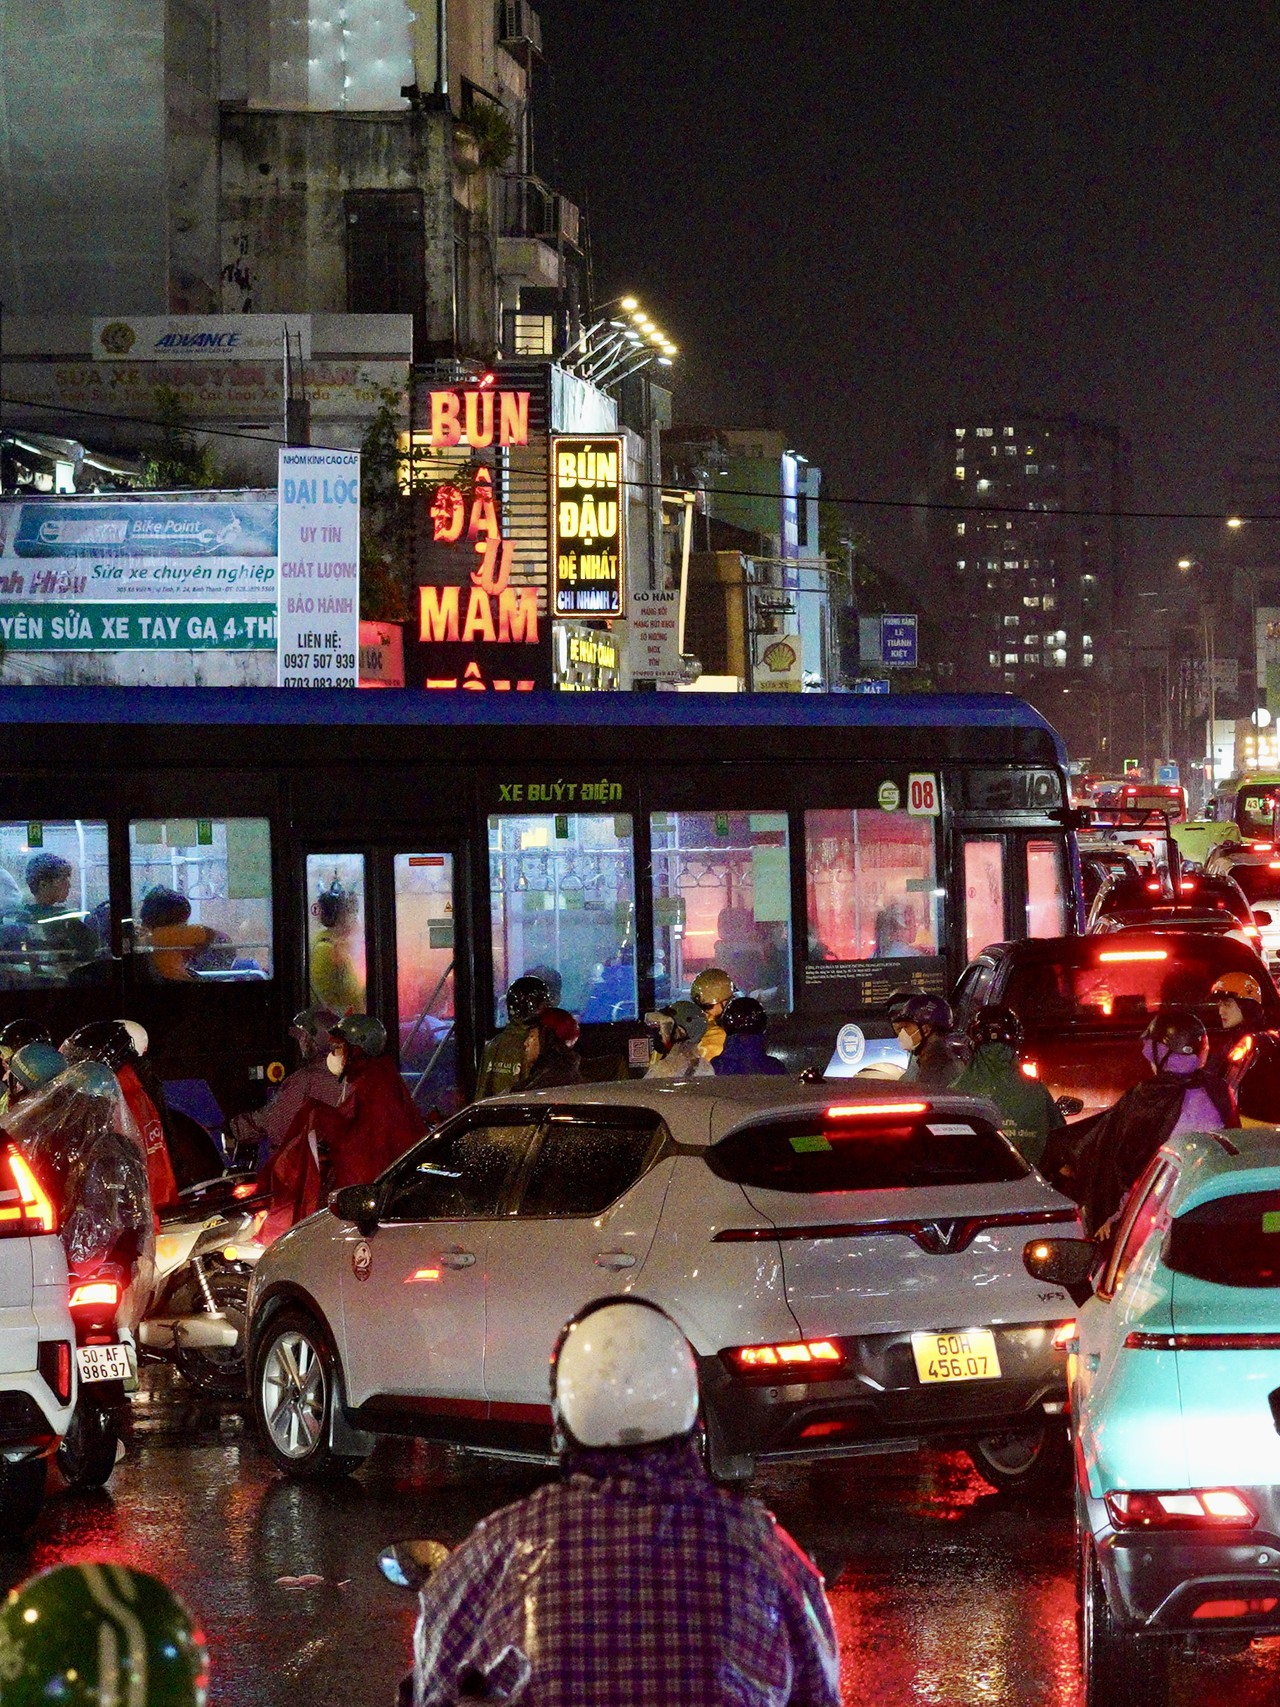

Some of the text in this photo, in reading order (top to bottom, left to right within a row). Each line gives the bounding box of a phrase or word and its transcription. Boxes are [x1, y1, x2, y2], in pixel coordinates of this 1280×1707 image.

[154, 332, 241, 347] ADVANCE
[429, 373, 531, 449] BÚN
[326, 454, 342, 465] CAO
[558, 445, 618, 488] BÚN
[284, 474, 358, 509] ĐẠI LỘC
[133, 520, 162, 532] Bike
[164, 520, 201, 532] Point
[558, 493, 617, 546] ĐẬU
[300, 527, 317, 543] UY
[91, 564, 276, 584] Sửa xe chuyên nghiệp
[558, 546, 618, 585] ĐỆ NHẤT
[557, 587, 619, 610] CHI NHÁNH 2
[51, 609, 94, 639] SỬA
[101, 617, 129, 639] XE
[138, 616, 182, 639] TAY
[187, 616, 221, 639] GA
[223, 616, 237, 639] 4
[297, 630, 342, 652] LIÊN HỆ:
[284, 653, 356, 669] 0937 507 939
[498, 784, 523, 801] XE
[527, 779, 578, 801] BUÝT
[911, 780, 934, 809] 08
[936, 1335, 972, 1356] 60H
[82, 1362, 126, 1379] 986.97
[928, 1356, 988, 1378] 456.07
